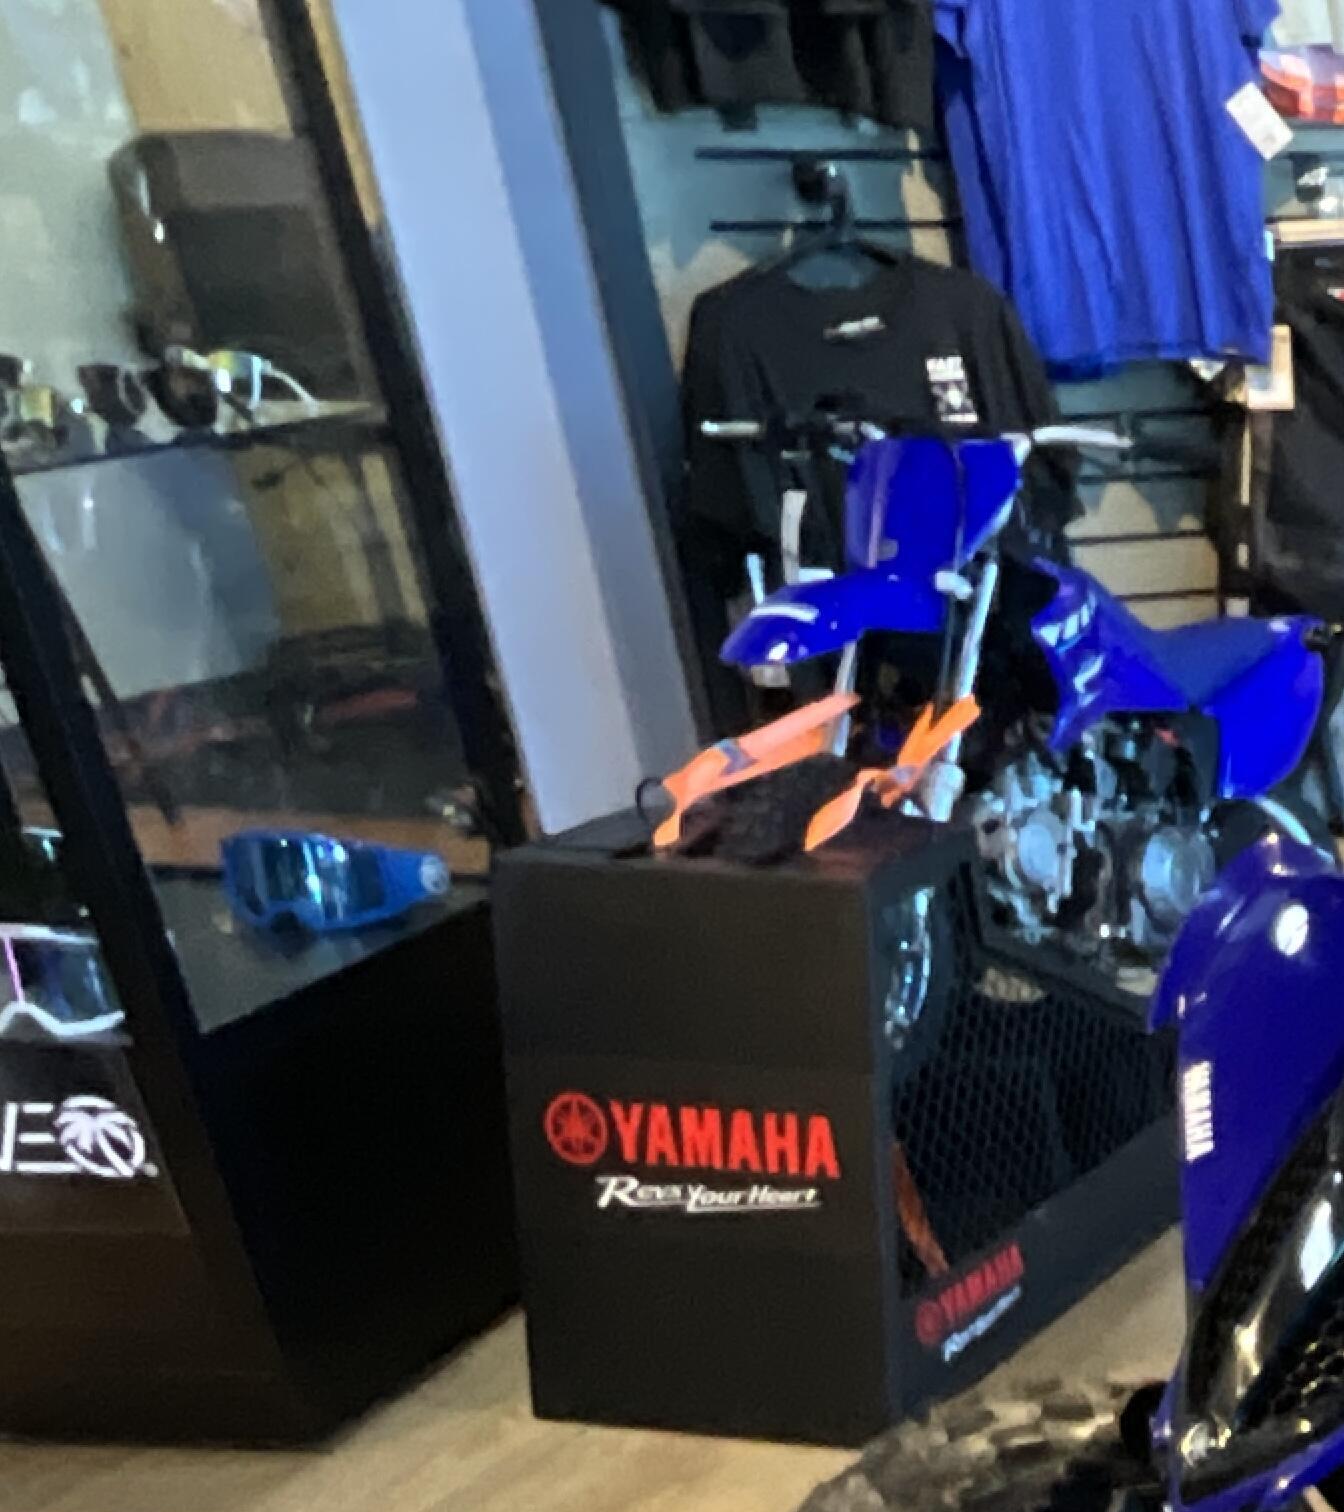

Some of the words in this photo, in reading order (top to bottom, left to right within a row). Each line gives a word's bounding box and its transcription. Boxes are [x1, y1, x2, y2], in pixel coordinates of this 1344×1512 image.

[608, 1099, 841, 1179] YAMAHA
[594, 1174, 684, 1209] Revs
[685, 1183, 743, 1213] Your
[746, 1184, 821, 1208] Heart
